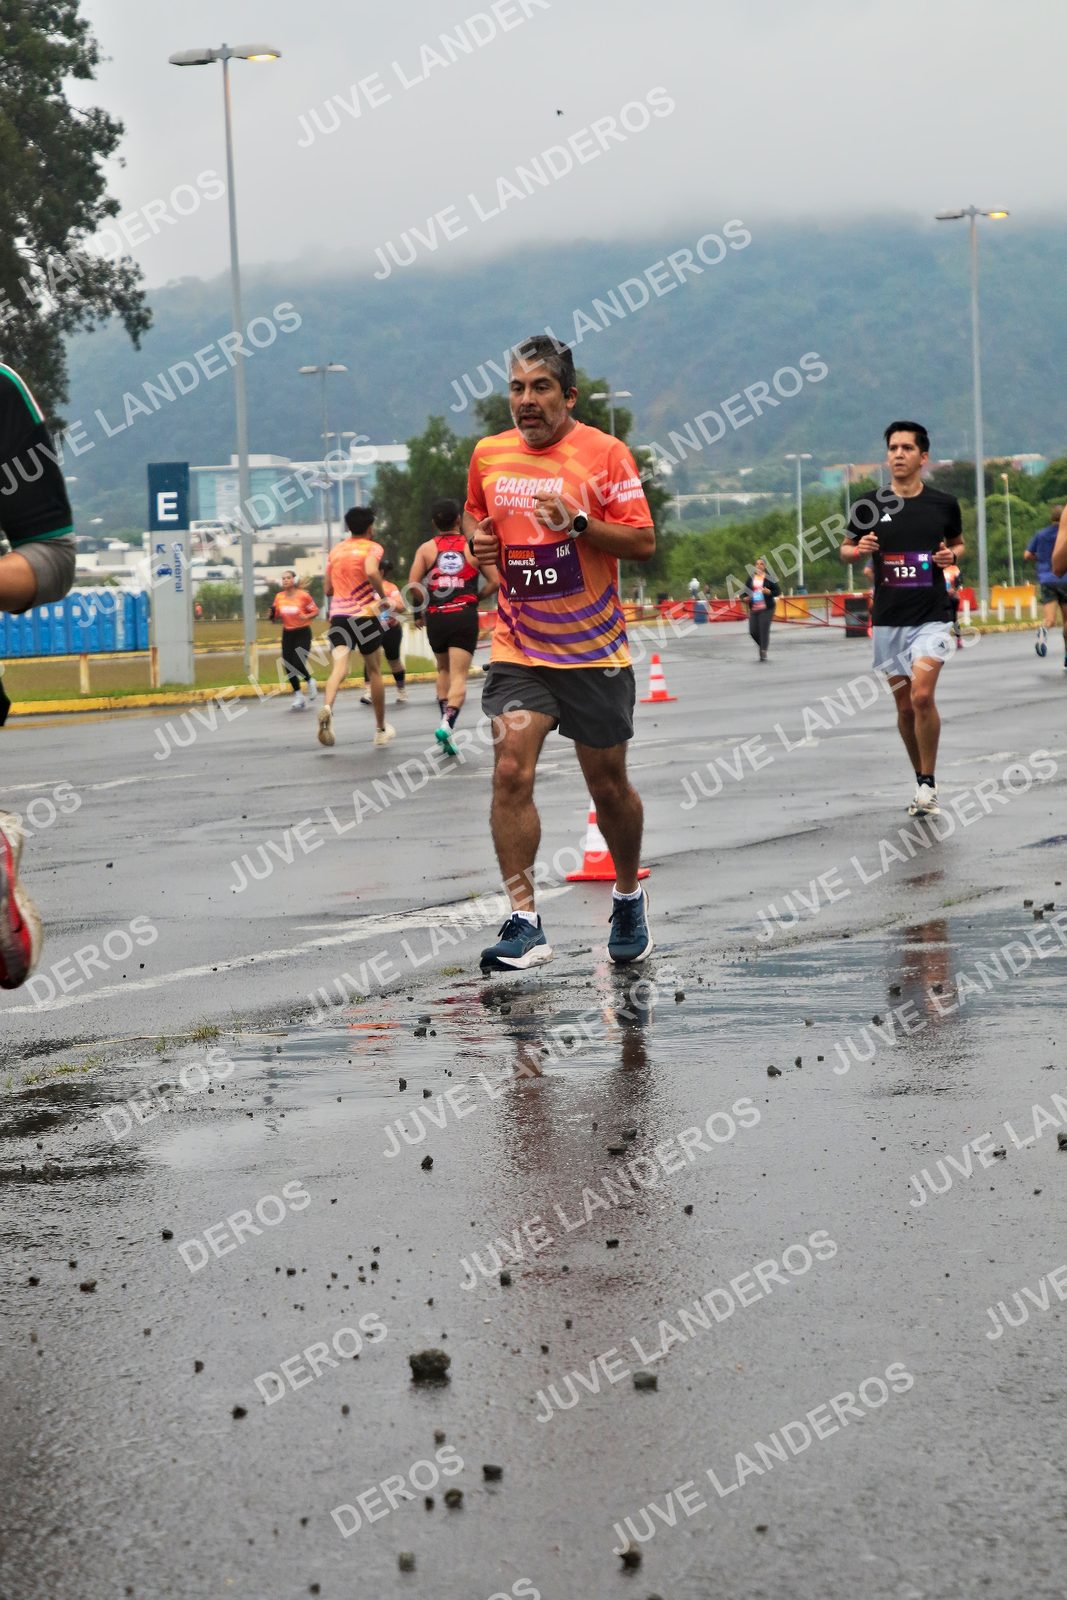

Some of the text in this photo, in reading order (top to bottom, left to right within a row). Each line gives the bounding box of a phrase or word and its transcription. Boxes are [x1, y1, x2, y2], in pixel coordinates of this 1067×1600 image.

[495, 476, 564, 497] CARRERA
[157, 491, 179, 521] E
[494, 495, 538, 509] OMNILIF
[556, 543, 571, 558] 15K
[522, 567, 558, 586] 719
[893, 566, 917, 578] 132
